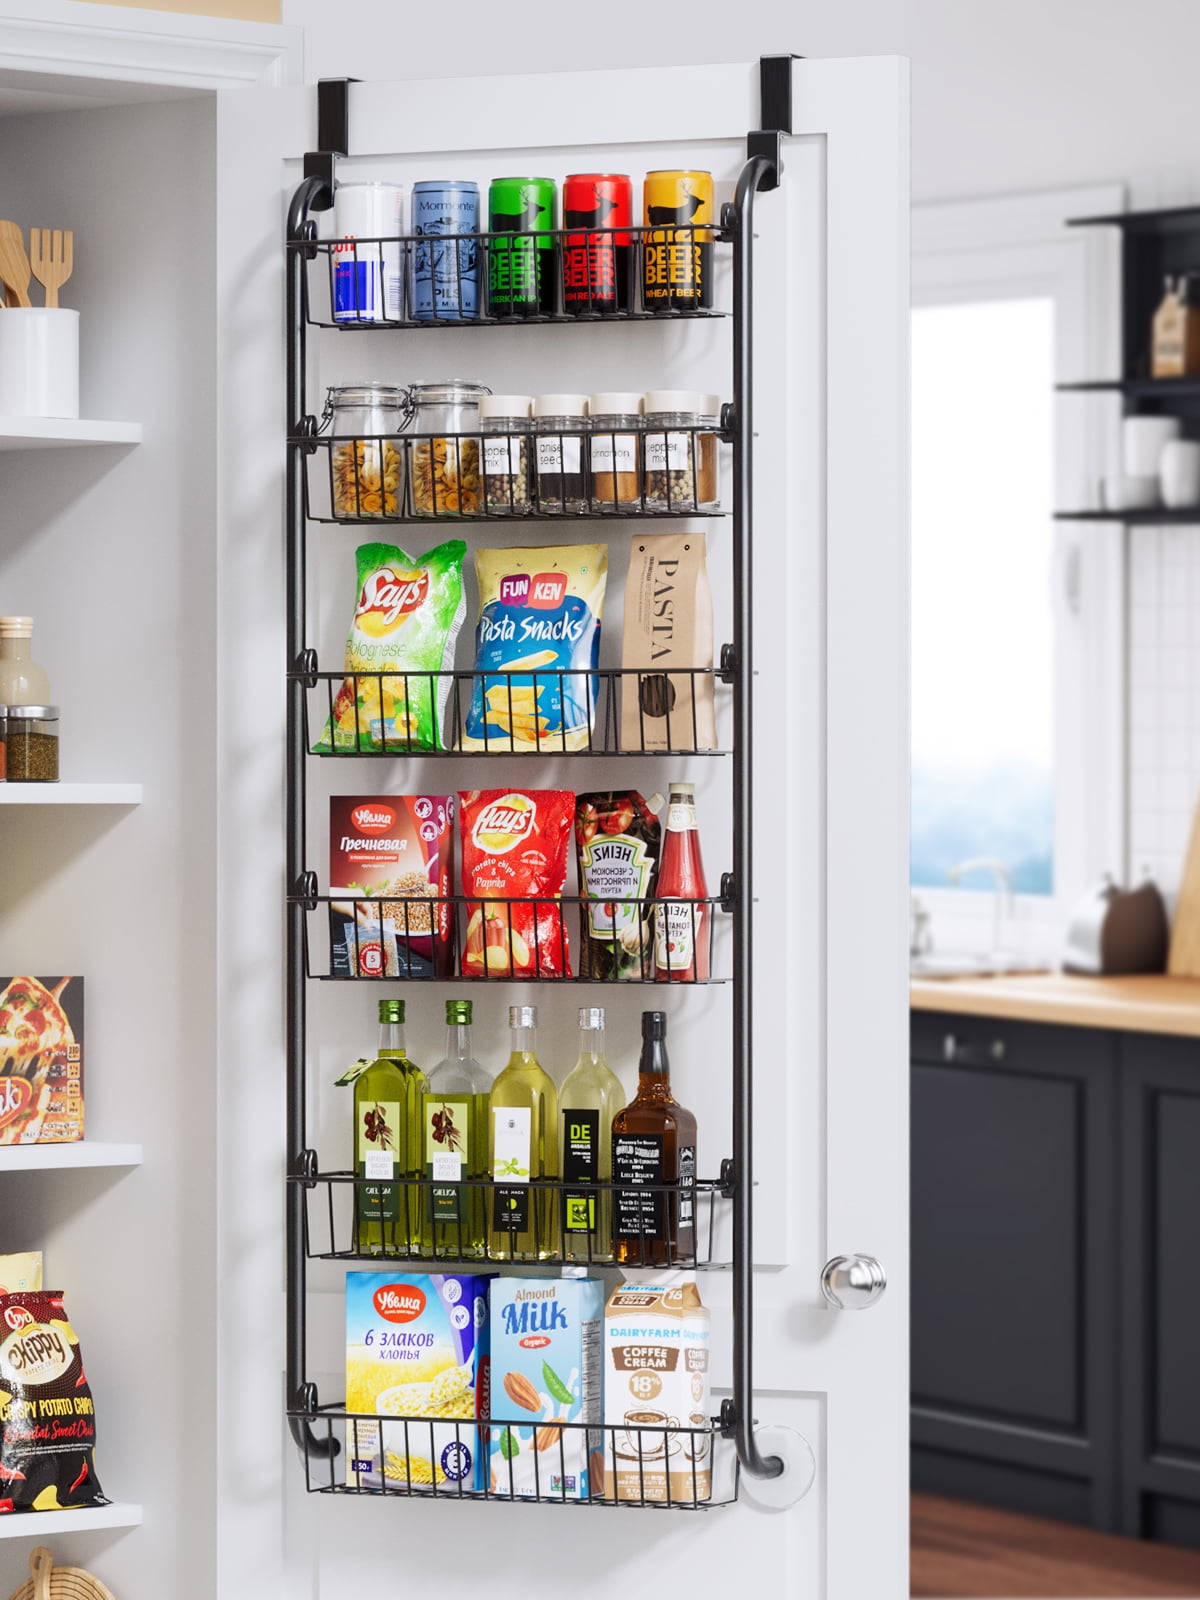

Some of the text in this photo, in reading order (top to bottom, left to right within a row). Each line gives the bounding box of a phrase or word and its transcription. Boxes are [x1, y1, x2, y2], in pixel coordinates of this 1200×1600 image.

[419, 201, 475, 212] Mormonte
[489, 252, 541, 271] DEER
[562, 248, 614, 269] DEER
[645, 245, 702, 265] DEER
[489, 271, 541, 290] BEER
[563, 268, 615, 288] BEER
[645, 265, 702, 284] BEER
[434, 287, 461, 299] PILS
[596, 291, 615, 301] ALE
[676, 287, 702, 298] BEER
[502, 579, 563, 601] FUN KEN
[651, 558, 680, 661] PASTA
[480, 611, 584, 644] Pasta Snacks
[345, 639, 408, 661] Bolognese
[340, 836, 408, 853] Гречневая
[475, 876, 506, 891] Paprika
[370, 954, 376, 962] 5
[570, 1124, 591, 1139] DE
[376, 1290, 421, 1311] Увелка
[514, 1286, 556, 1301] Almond
[501, 1300, 568, 1335] Milk
[364, 1328, 434, 1347] 6 злаков
[609, 1327, 681, 1338] DAIRYFARM
[522, 1337, 548, 1348] Organic
[622, 1346, 669, 1358] COFFEE
[378, 1349, 421, 1360] хлопья
[623, 1357, 668, 1368] CREAM
[39, 1397, 73, 1417] POTATO
[73, 1396, 94, 1415] CHIPS
[50, 1419, 77, 1440] Sweet
